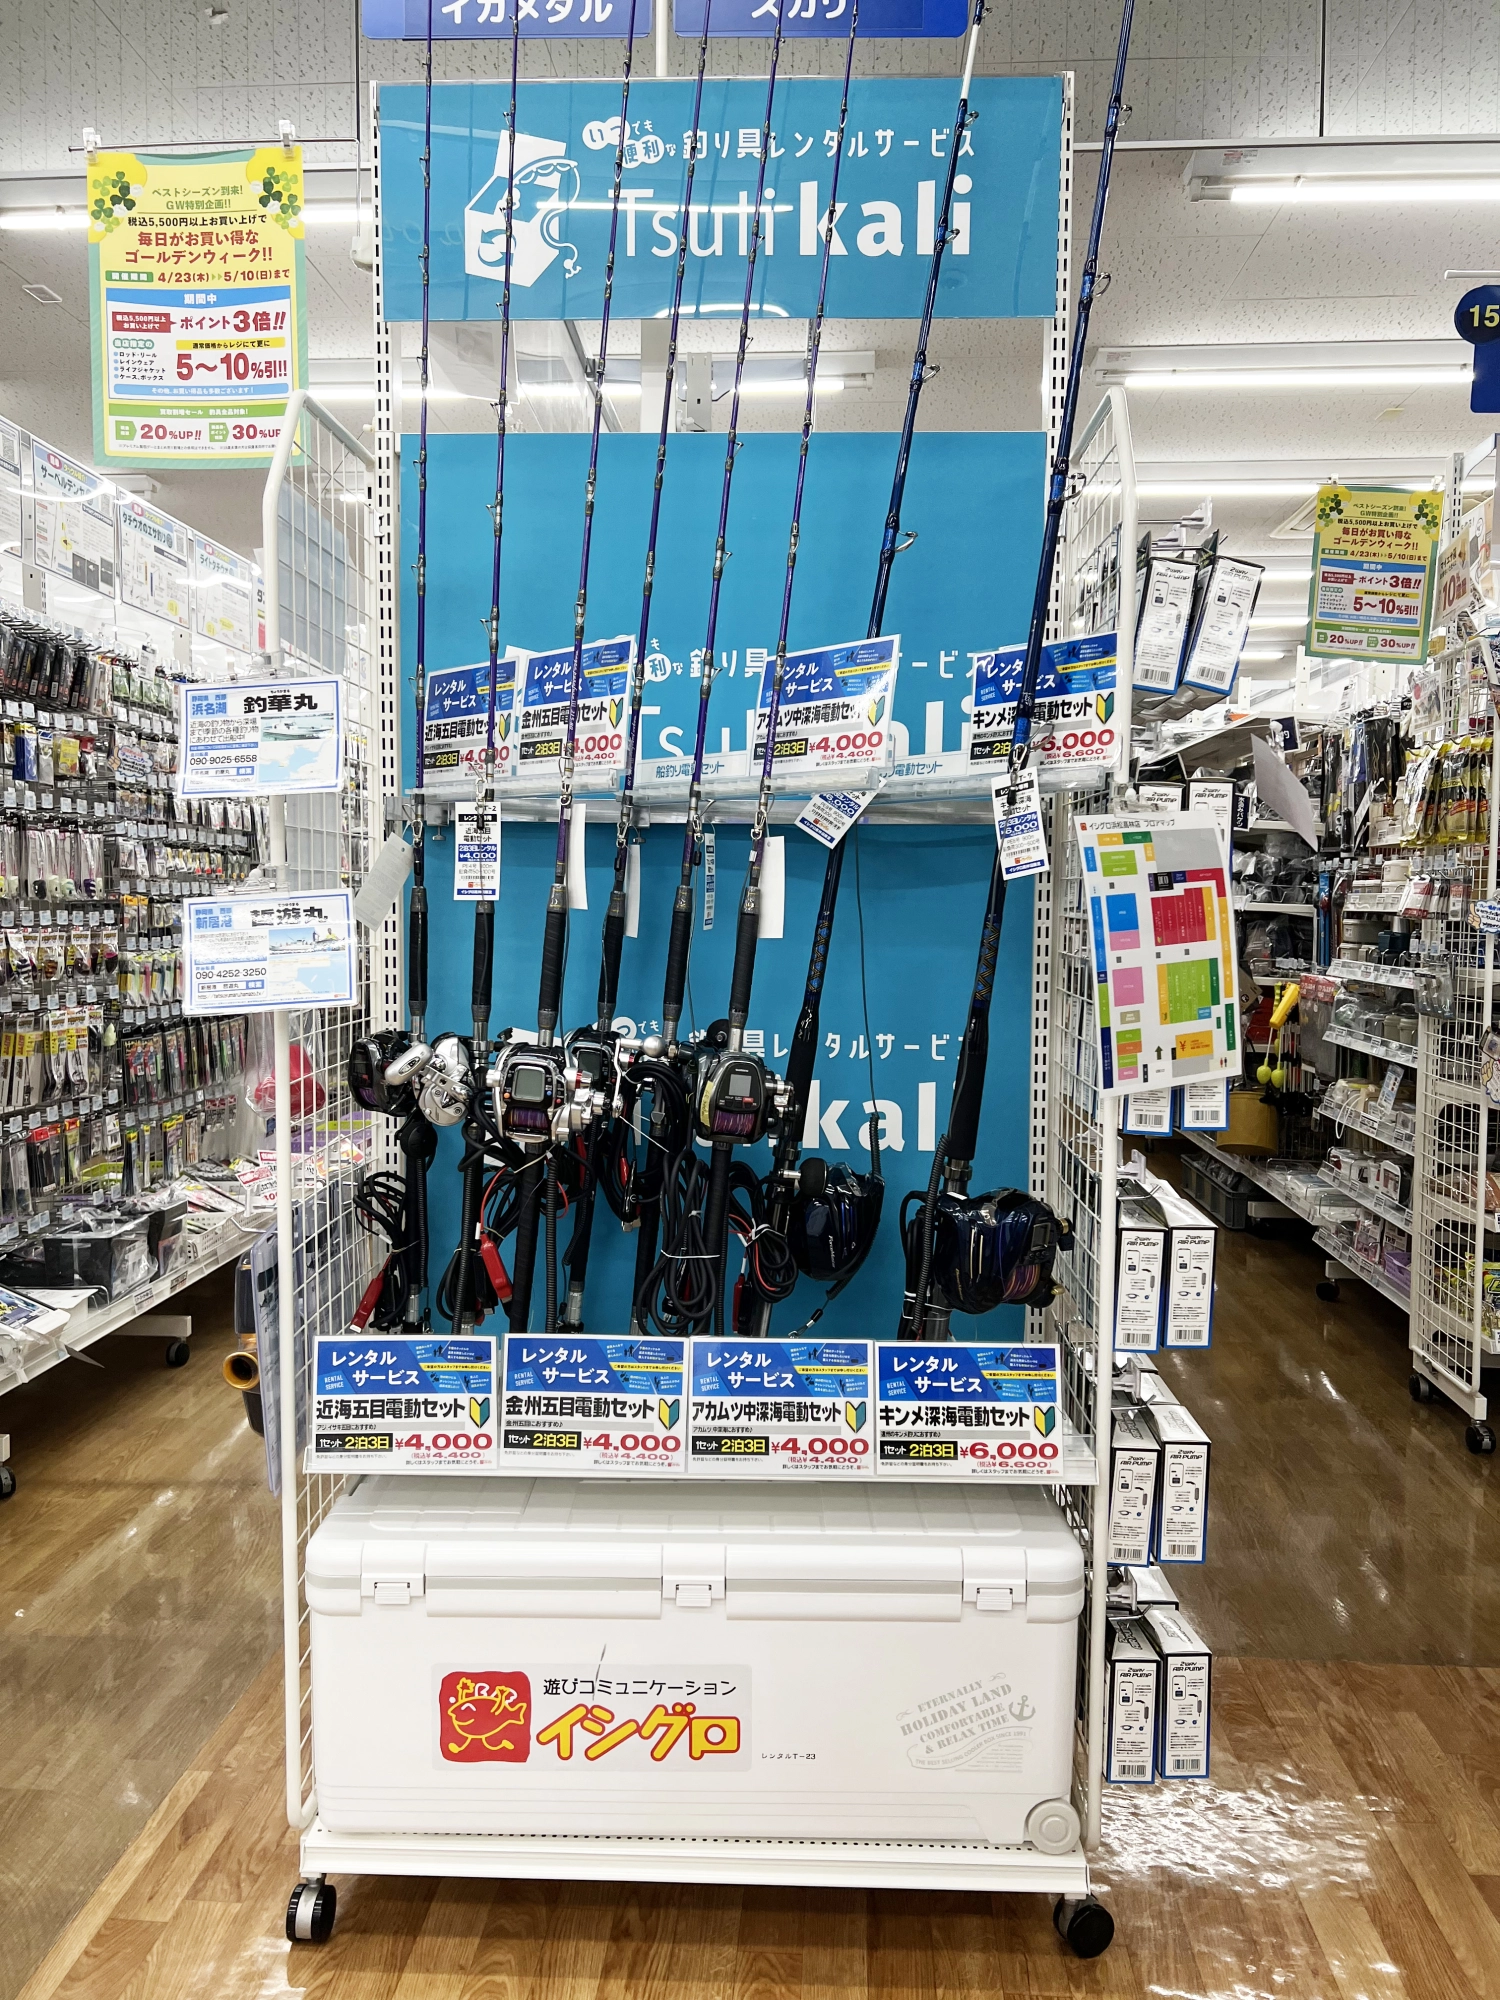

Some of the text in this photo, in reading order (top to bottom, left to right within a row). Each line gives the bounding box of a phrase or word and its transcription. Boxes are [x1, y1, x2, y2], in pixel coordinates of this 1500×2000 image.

[152, 185, 243, 197] ベストシーズン到来!
[128, 215, 267, 227] 税込5,500円以上お買い上げで
[800, 174, 973, 257] kali
[138, 229, 259, 246] 毎日がお買い得な
[125, 247, 273, 264] ゴールデンウィーク!!
[184, 293, 217, 305] 期間中
[180, 311, 286, 332] ポイント3倍!!
[1470, 305, 1500, 327] 15
[1342, 527, 1411, 539] 毎日がお買い得な
[1333, 538, 1418, 550] ゴールデンウィーク!!
[534, 662, 571, 679] レンタル
[434, 681, 467, 696] レンタル
[785, 676, 833, 697] サービス
[192, 702, 226, 715] 浜名湖
[244, 694, 318, 714] 釣華丸
[443, 695, 476, 711] サービス
[534, 743, 560, 756] 2泊3日
[809, 731, 883, 754] ¥4,000
[190, 755, 257, 765] 090-9025-6558
[196, 968, 266, 980] 090-4252-3250
[332, 1350, 397, 1367] レンタル
[522, 1348, 587, 1364] レンタル
[707, 1351, 771, 1368] レンタル
[893, 1356, 958, 1373] レンタル
[352, 1369, 420, 1386] サービス
[516, 1378, 534, 1386] SERVICE
[542, 1367, 609, 1384] サービス
[728, 1372, 794, 1388] サービス
[326, 1382, 344, 1390] SERVICE
[888, 1388, 906, 1396] SERVICE
[915, 1376, 982, 1393] サービス
[316, 1398, 465, 1419] 近海五目電動セット
[506, 1396, 654, 1418] 金州五目電動セット
[692, 1401, 841, 1422] アカムツ中深海電動セット
[880, 1406, 1029, 1427] キンメ深海電動セット
[320, 1436, 389, 1449] 1セット 2泊3日
[395, 1433, 492, 1451] ¥4,000
[508, 1433, 578, 1447] 1セット 2泊3日
[584, 1434, 681, 1452] ¥4,000
[696, 1439, 765, 1452] 1セット 2泊3日
[771, 1437, 869, 1455] ¥4,000
[884, 1444, 954, 1457] 1セット 2泊3日
[960, 1442, 1058, 1460] ¥6,000
[543, 1678, 737, 1696] 遊びコミュニケーション
[918, 1680, 982, 1713] ETERNALLY
[900, 1684, 1012, 1736] HOLIDAY LAND
[536, 1702, 741, 1761] イシグロ
[920, 1703, 1005, 1743] COMFORTABLE
[937, 1728, 976, 1750] RELAX
[978, 1714, 1009, 1732] TIME
